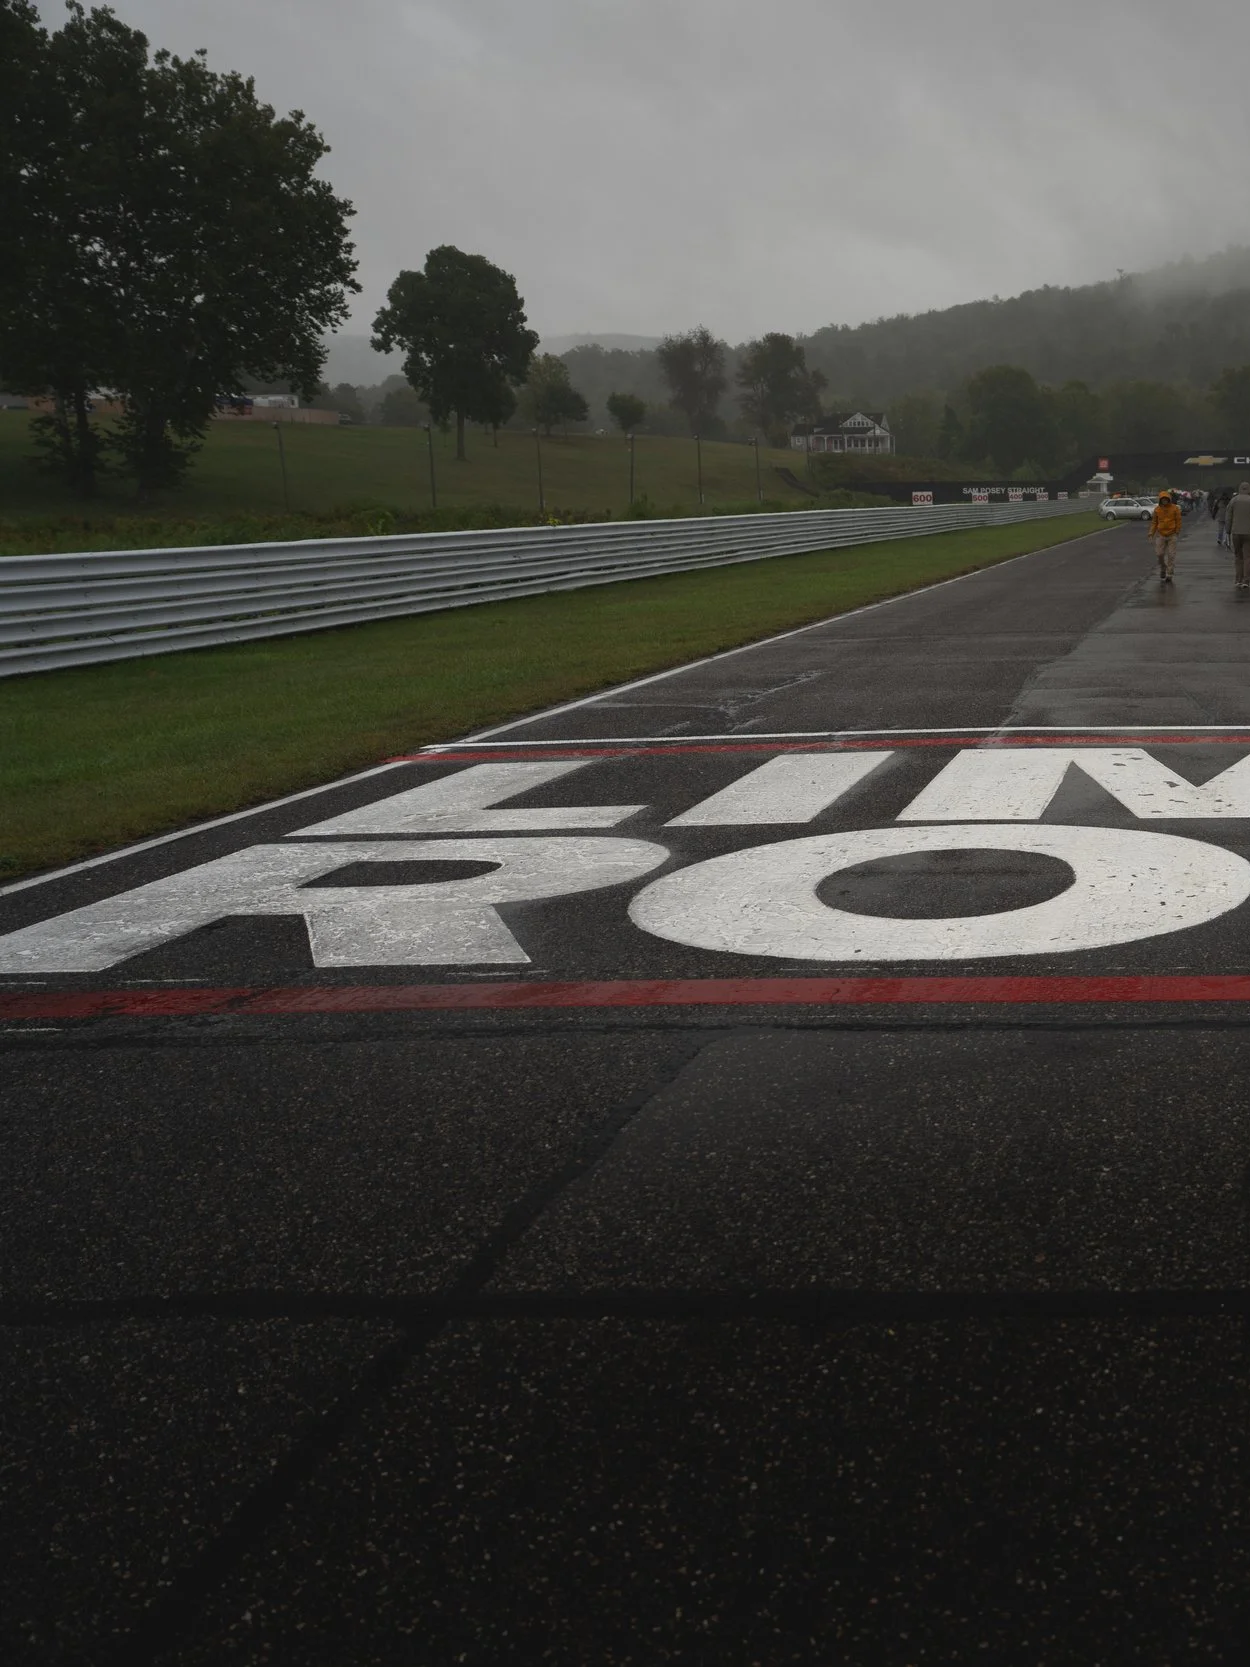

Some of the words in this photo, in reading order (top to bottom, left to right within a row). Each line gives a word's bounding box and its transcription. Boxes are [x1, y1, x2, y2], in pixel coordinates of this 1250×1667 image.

[962, 487, 978, 495] SAM
[980, 487, 1005, 495] POSEY
[913, 494, 933, 503] 600
[973, 494, 988, 502] 500
